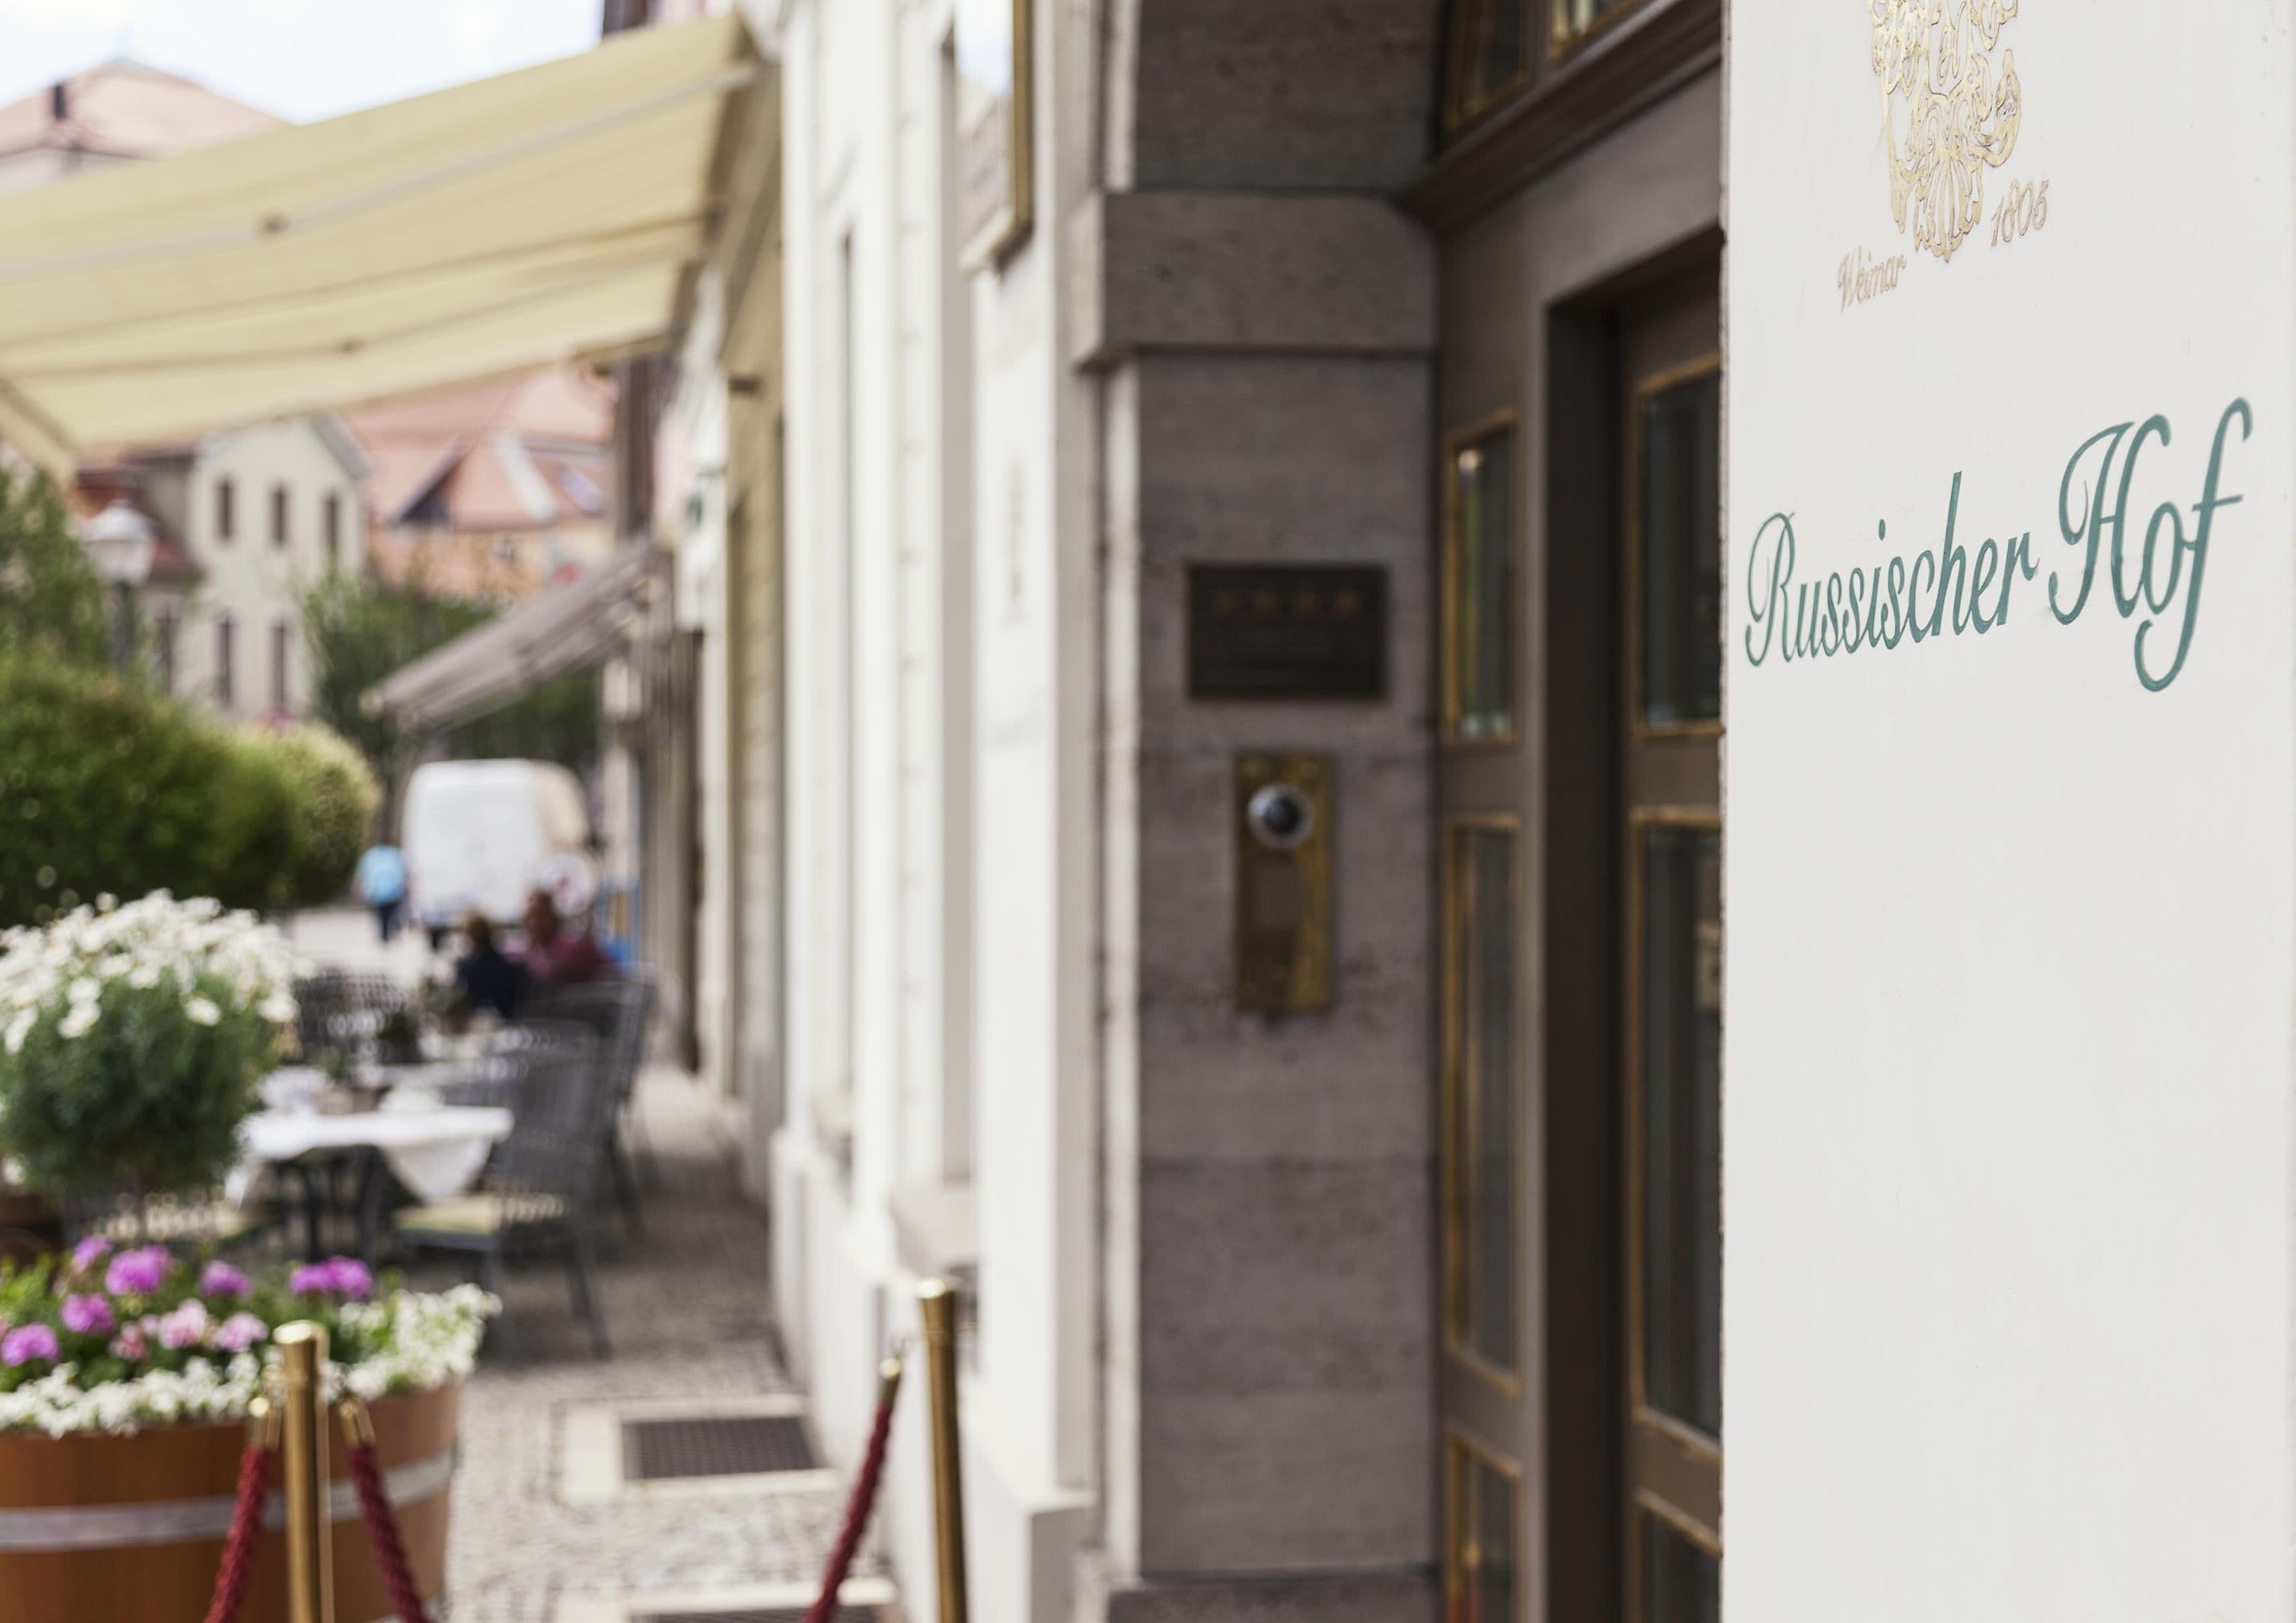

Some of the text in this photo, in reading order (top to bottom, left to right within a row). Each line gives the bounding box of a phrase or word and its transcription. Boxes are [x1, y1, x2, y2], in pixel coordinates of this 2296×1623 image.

[1837, 244, 1907, 312] Weimar
[1744, 396, 2254, 694] Russischer Hof
